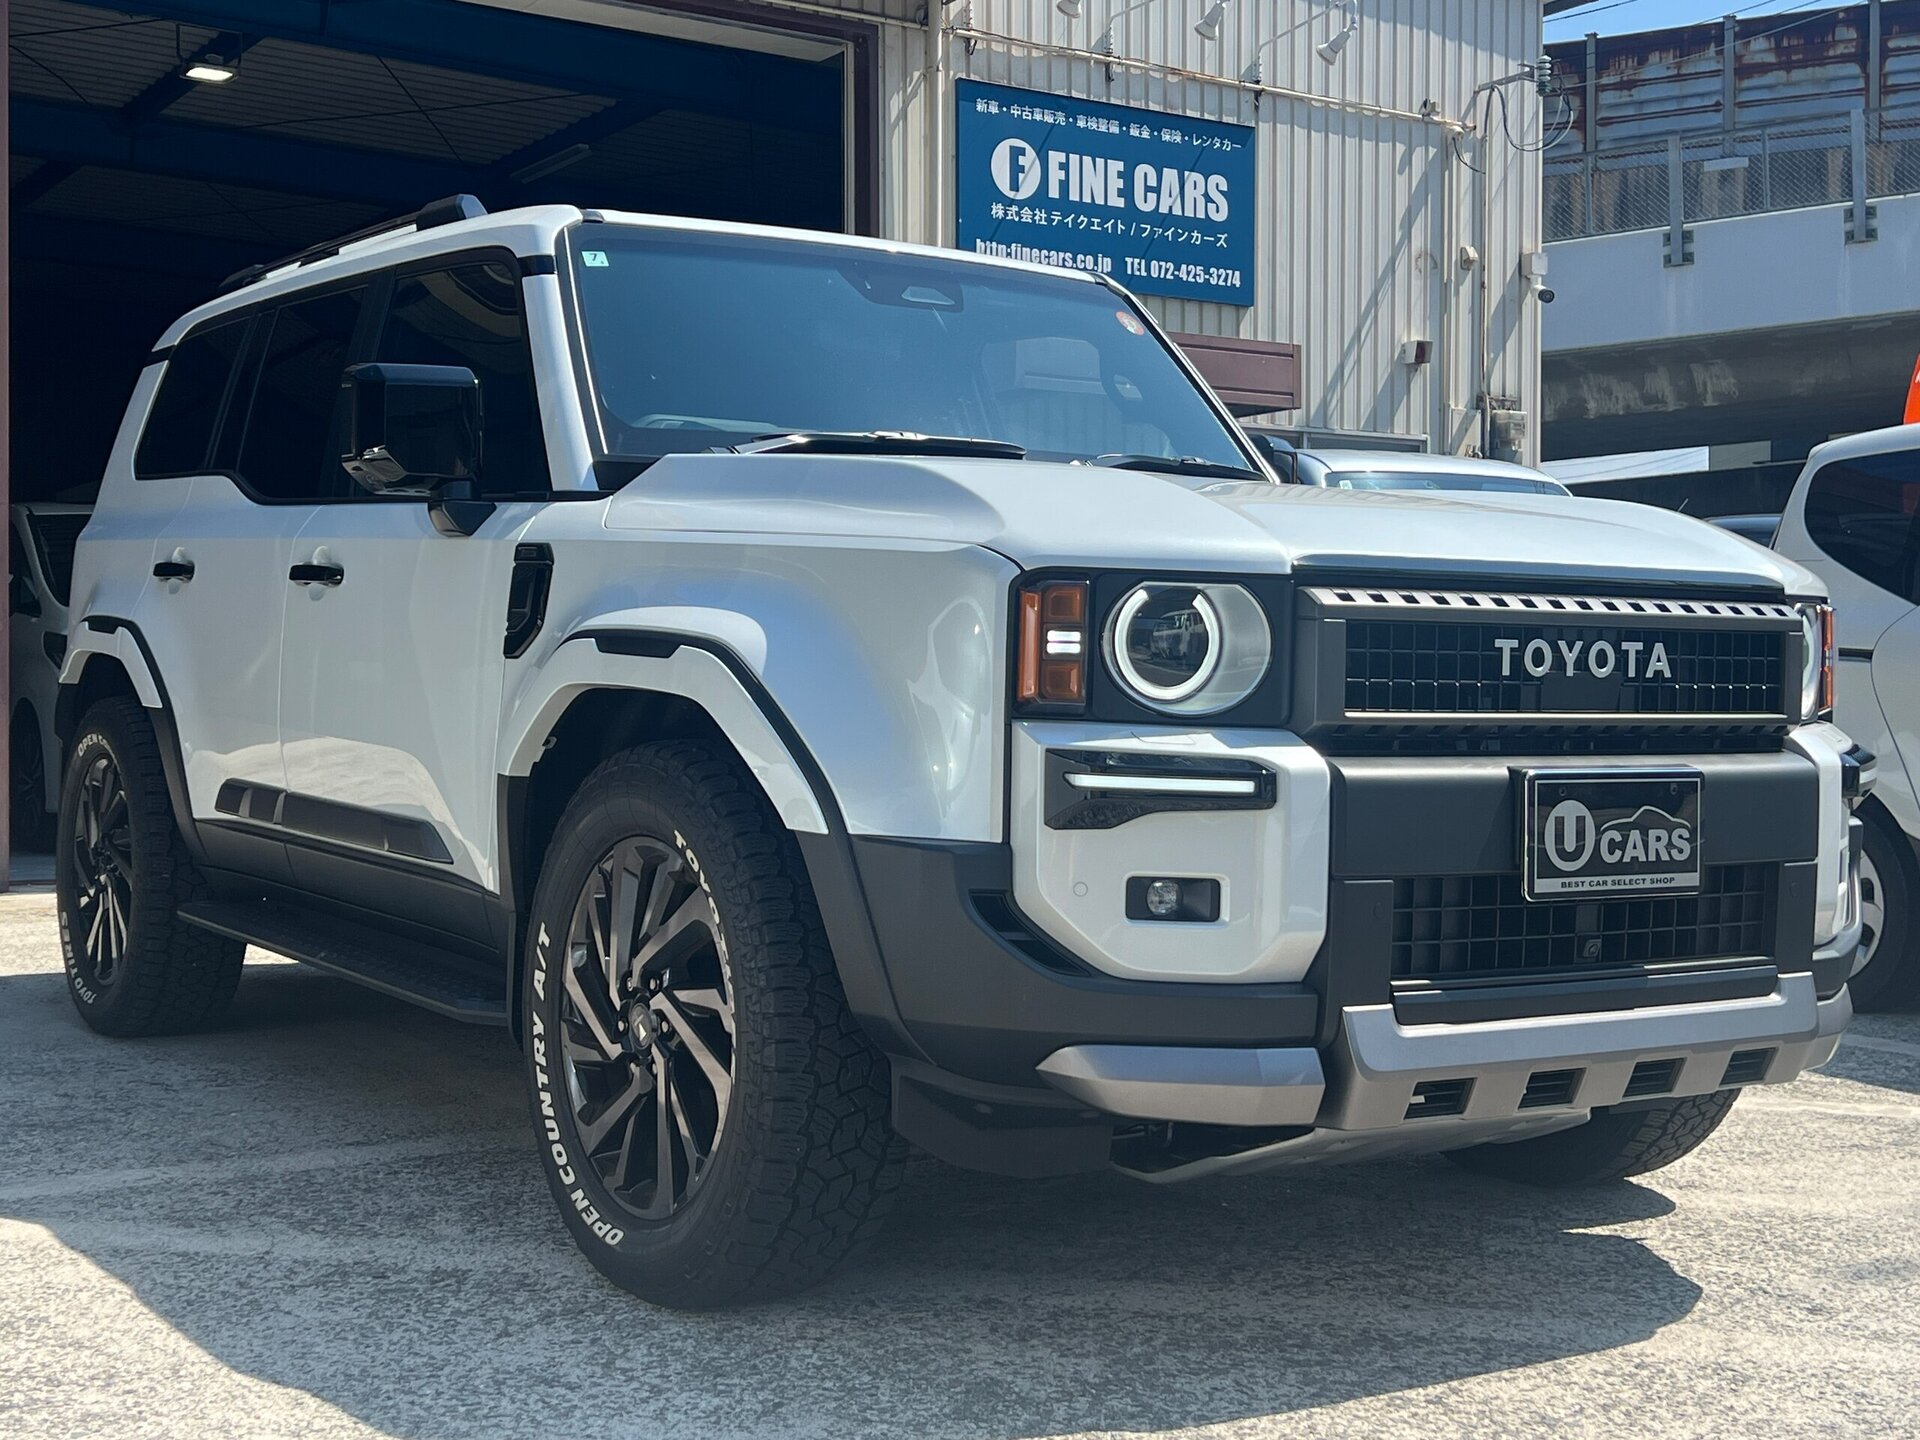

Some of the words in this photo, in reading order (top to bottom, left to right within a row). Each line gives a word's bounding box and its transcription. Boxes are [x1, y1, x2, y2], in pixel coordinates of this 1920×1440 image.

[1048, 150, 1125, 208] FINE
[1133, 163, 1228, 222] CARS
[1125, 257, 1147, 277] TEL
[1151, 259, 1241, 288] 072-425-3274
[1494, 638, 1672, 679] TOYOTA
[78, 733, 98, 757] OPEN
[1600, 828, 1691, 863] CARS
[1561, 880, 1586, 888] BEST
[1610, 878, 1647, 887] SELECT
[532, 921, 551, 1001] A/T
[532, 1011, 577, 1185] COUNTRY
[570, 1187, 624, 1245] OPEN
